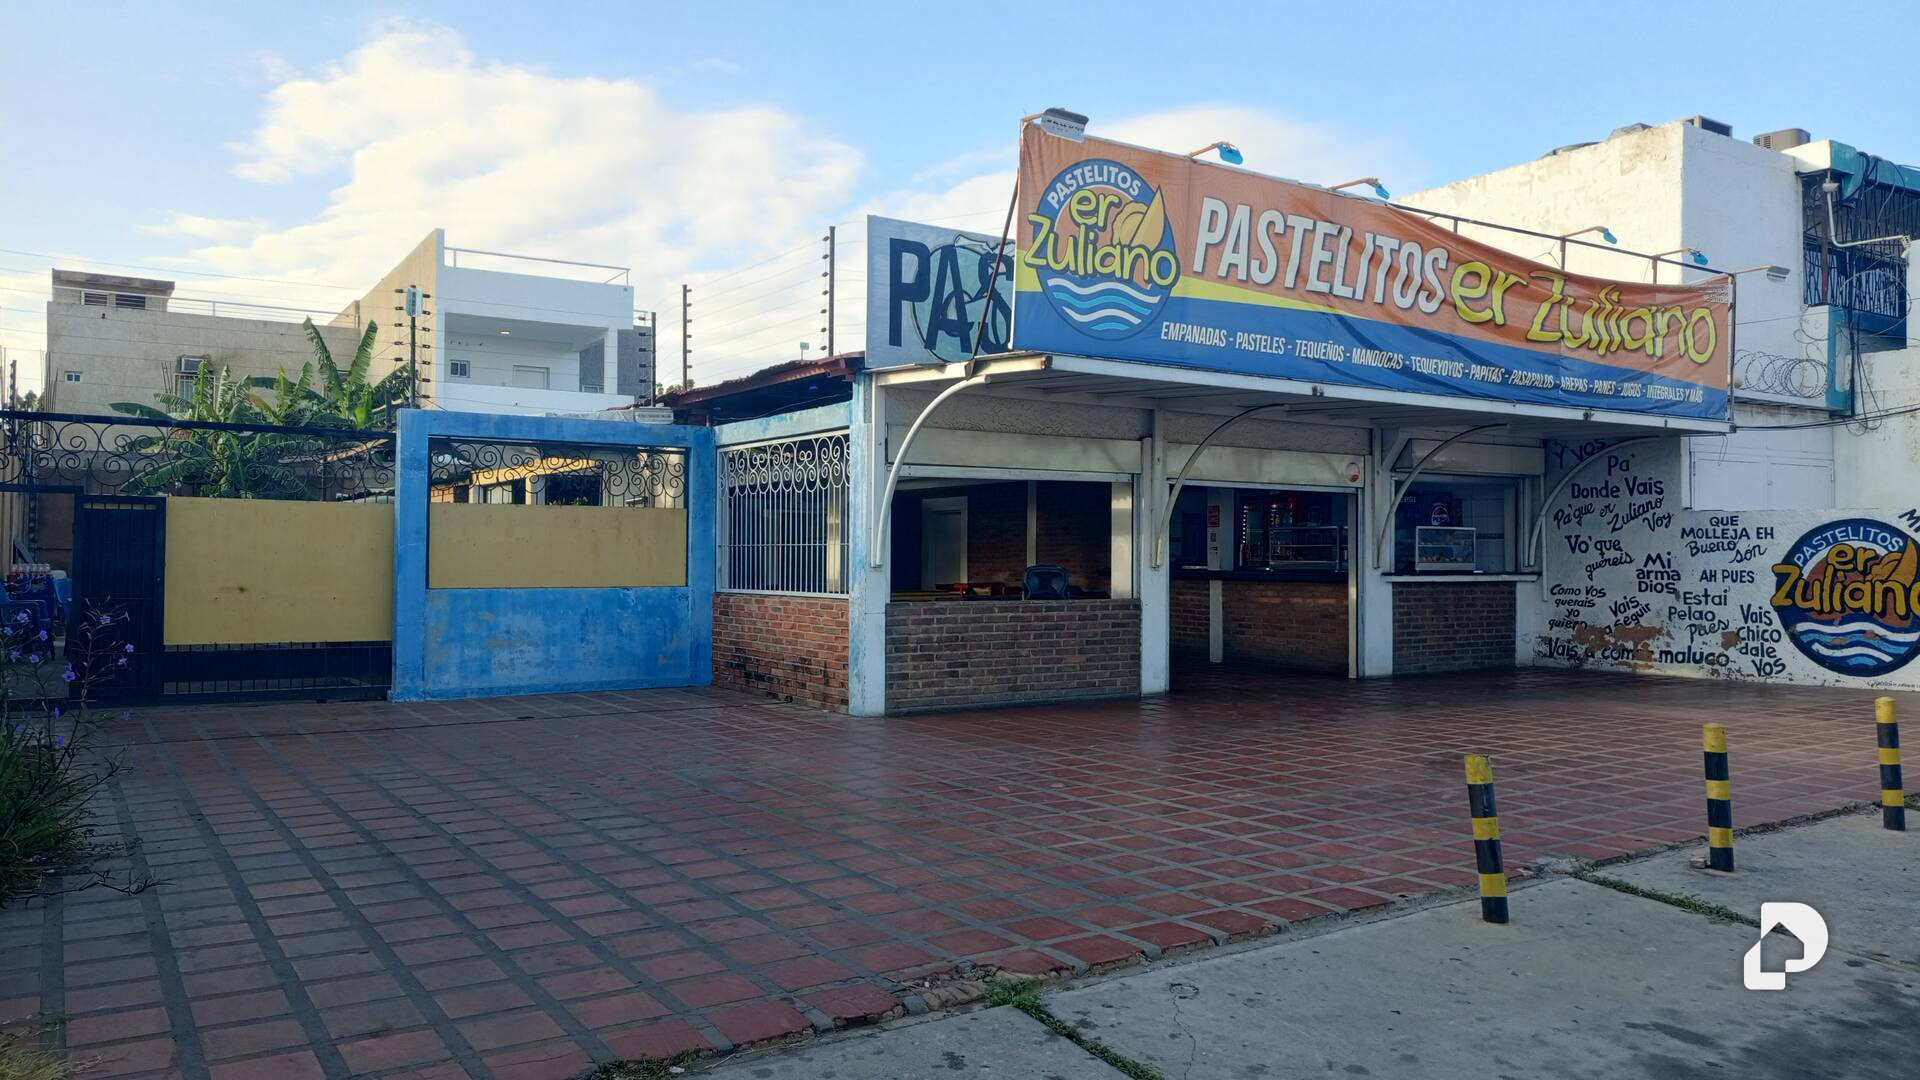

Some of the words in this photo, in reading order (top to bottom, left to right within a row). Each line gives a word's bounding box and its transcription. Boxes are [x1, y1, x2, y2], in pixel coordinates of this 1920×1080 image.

[1047, 165, 1142, 210] PASTELITOS
[1069, 189, 1121, 231] er
[1024, 213, 1181, 288] Zuliano
[1193, 197, 1448, 314] PASTELITOS
[1450, 261, 1528, 326] er
[1526, 271, 1717, 365] Zuliano
[1161, 321, 1227, 347] EMPANADAS
[1236, 332, 1286, 355] PASTELES
[1295, 339, 1345, 362] TEQUEÑOS
[1351, 347, 1404, 370] MANDOCAS
[1410, 356, 1464, 378] TEQUEYOYOS
[1469, 364, 1506, 384] PAPITAS
[1508, 369, 1555, 389] PASAPALOS
[1560, 376, 1588, 393] AREPAS
[1593, 379, 1617, 396] PANES
[1620, 382, 1642, 398] JUGOS
[1646, 383, 1685, 401] INTEGRALES
[1571, 480, 1621, 499] Donde
[1624, 476, 1665, 497] Vais
[1599, 503, 1616, 518] er
[1606, 495, 1665, 534] Zuliano
[1642, 512, 1674, 532] Voy
[1709, 515, 1739, 527] QUE
[1681, 527, 1751, 540] MOLLEJA
[1756, 527, 1775, 540] EH
[1685, 540, 1740, 558] Bueno
[1793, 525, 1904, 567] PASTELITOS
[1643, 551, 1672, 569] Mi
[1826, 542, 1878, 573] er
[1636, 568, 1681, 581] arma
[1699, 569, 1717, 583] AH
[1721, 569, 1756, 584] PUES
[1550, 583, 1582, 596] Como
[1585, 585, 1607, 599] Vos
[1638, 580, 1677, 594] Dios
[1609, 595, 1640, 619] Vais
[1668, 605, 1716, 622] Pelao
[1740, 603, 1774, 627] Vais
[1739, 642, 1777, 659] dale
